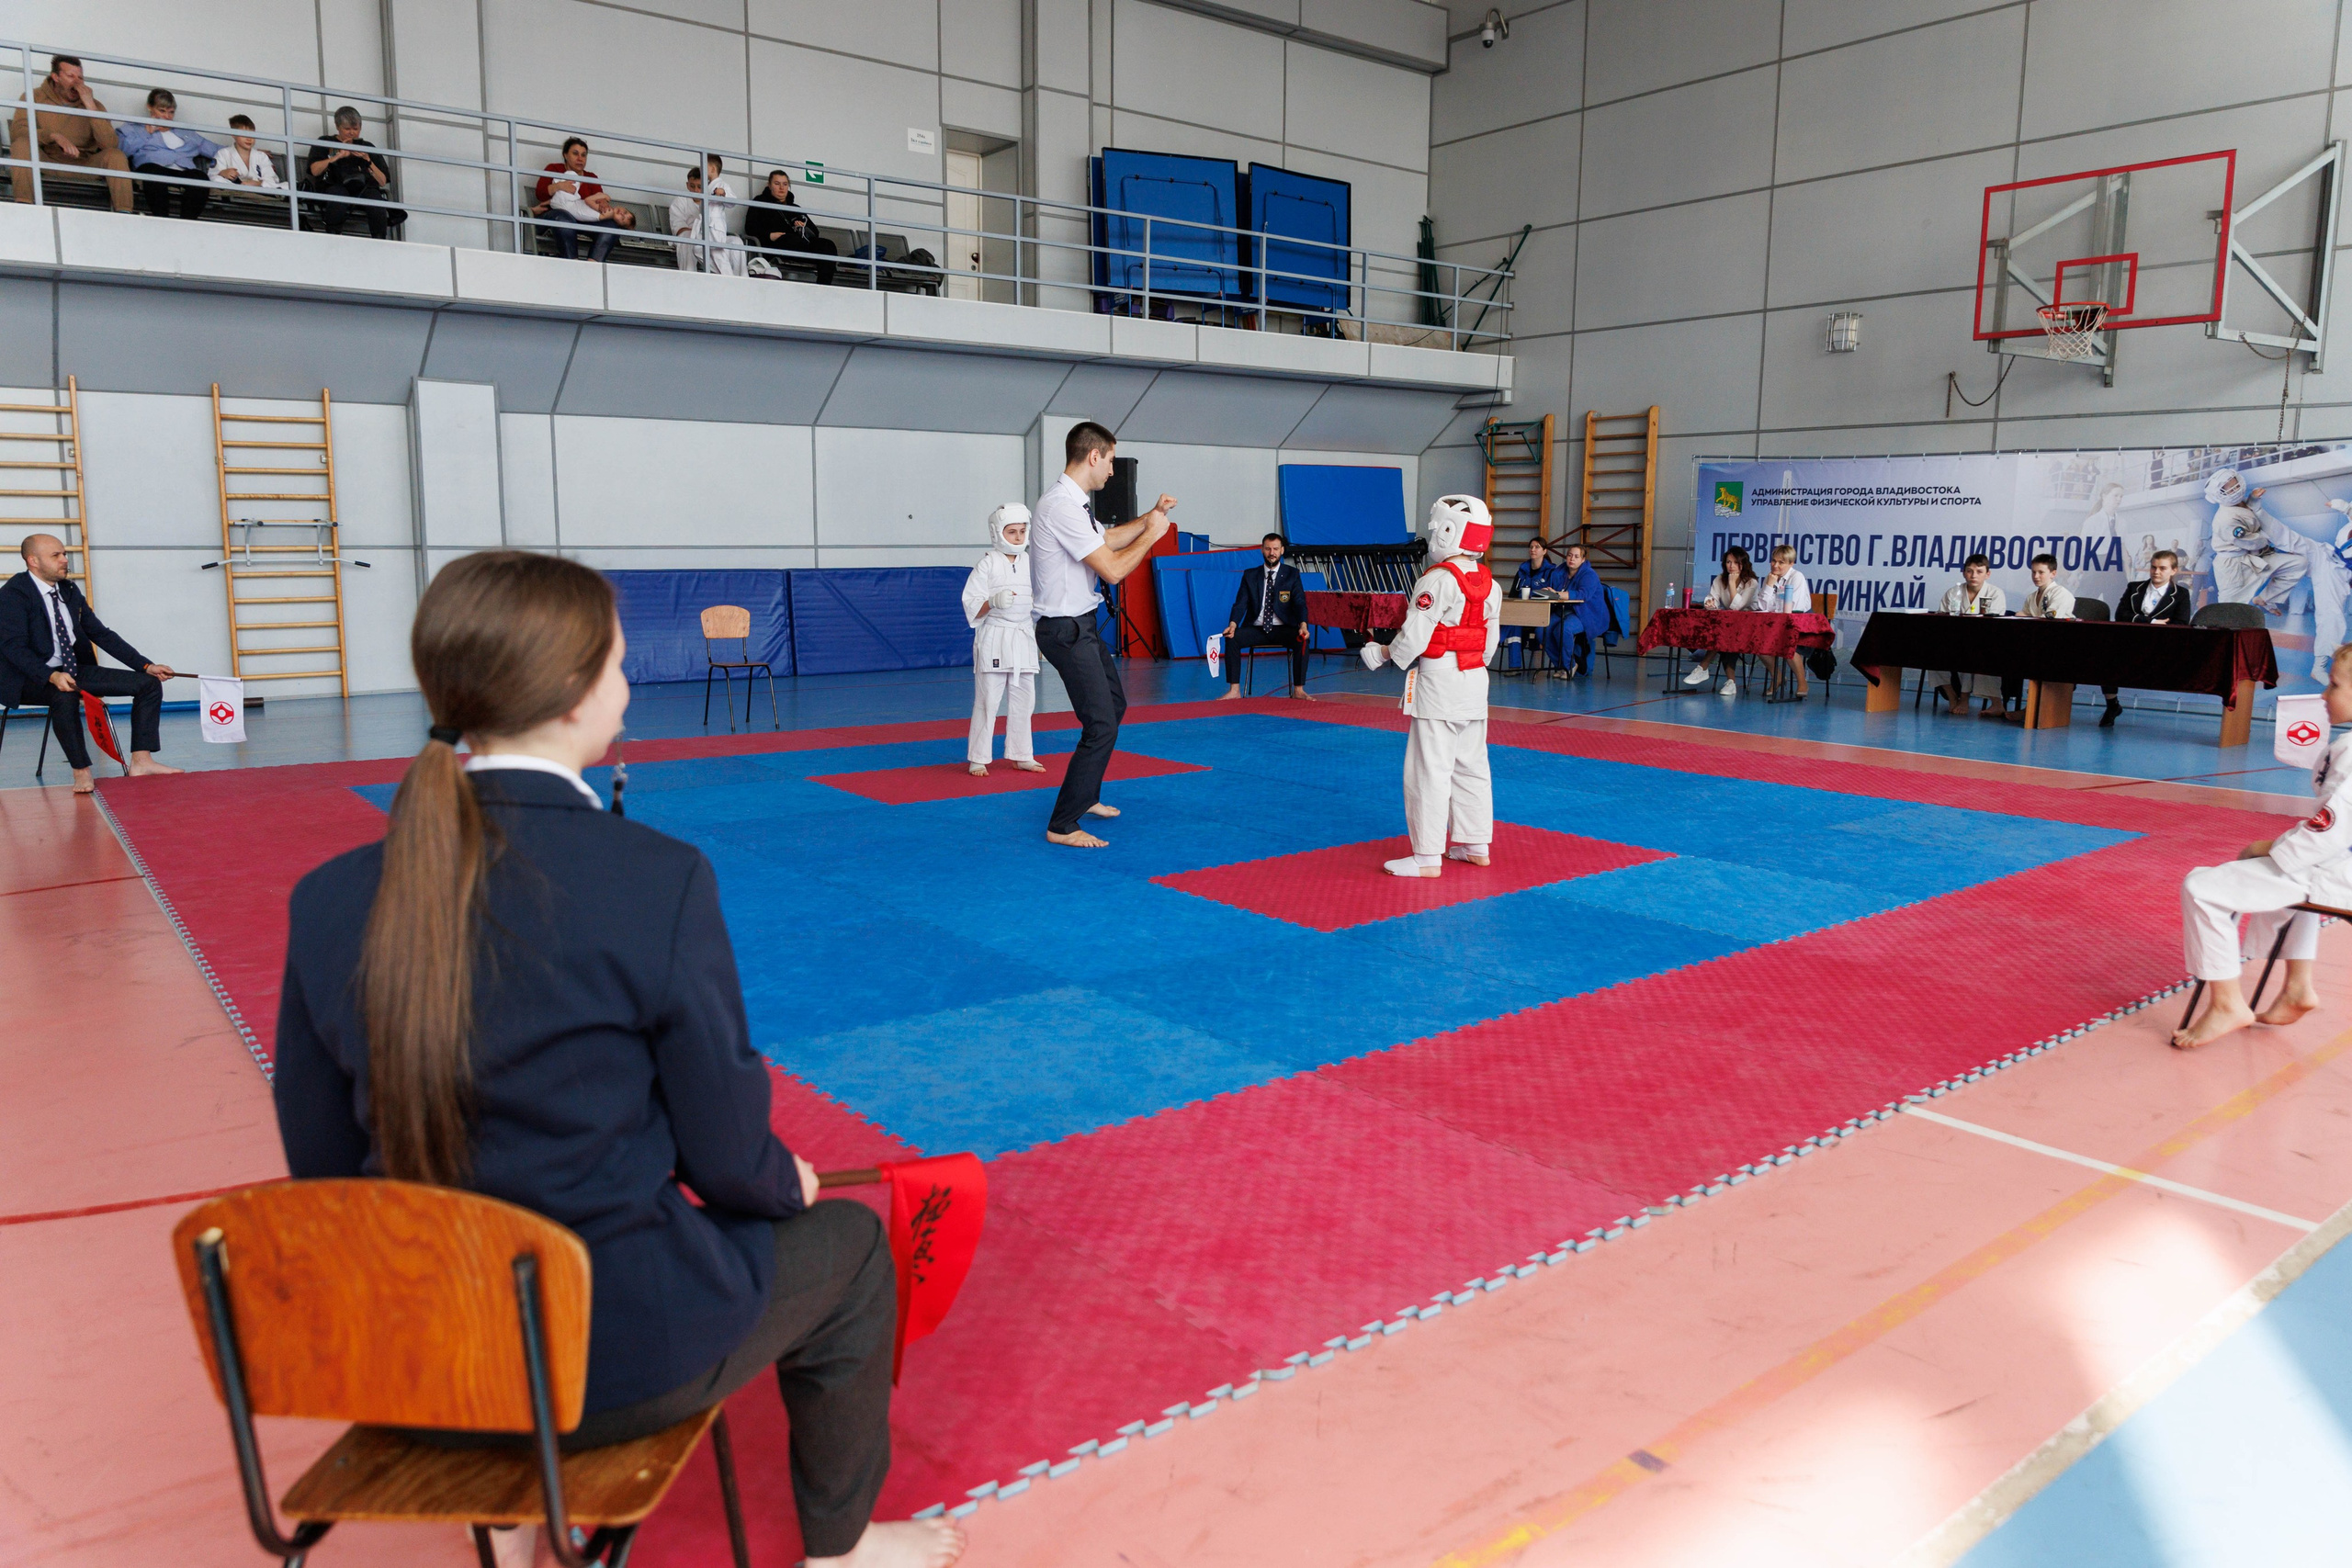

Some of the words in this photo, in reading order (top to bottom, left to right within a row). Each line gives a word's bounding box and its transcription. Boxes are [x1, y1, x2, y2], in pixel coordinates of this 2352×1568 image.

[1751, 488, 1833, 497] АДМИНИСТРАЦИЯ
[1834, 487, 1874, 497] ГОРОДА
[1875, 486, 1962, 496] ВЛАДИВОСТОКА
[1750, 498, 1809, 506] УПРАВЛЕНИЕ
[1810, 496, 1875, 506] ФИЗИЧЕСКОЙ
[1876, 497, 1929, 506] КУЛЬТУРЫ
[1930, 497, 1939, 505] И
[1939, 497, 1982, 505] СПОРТА
